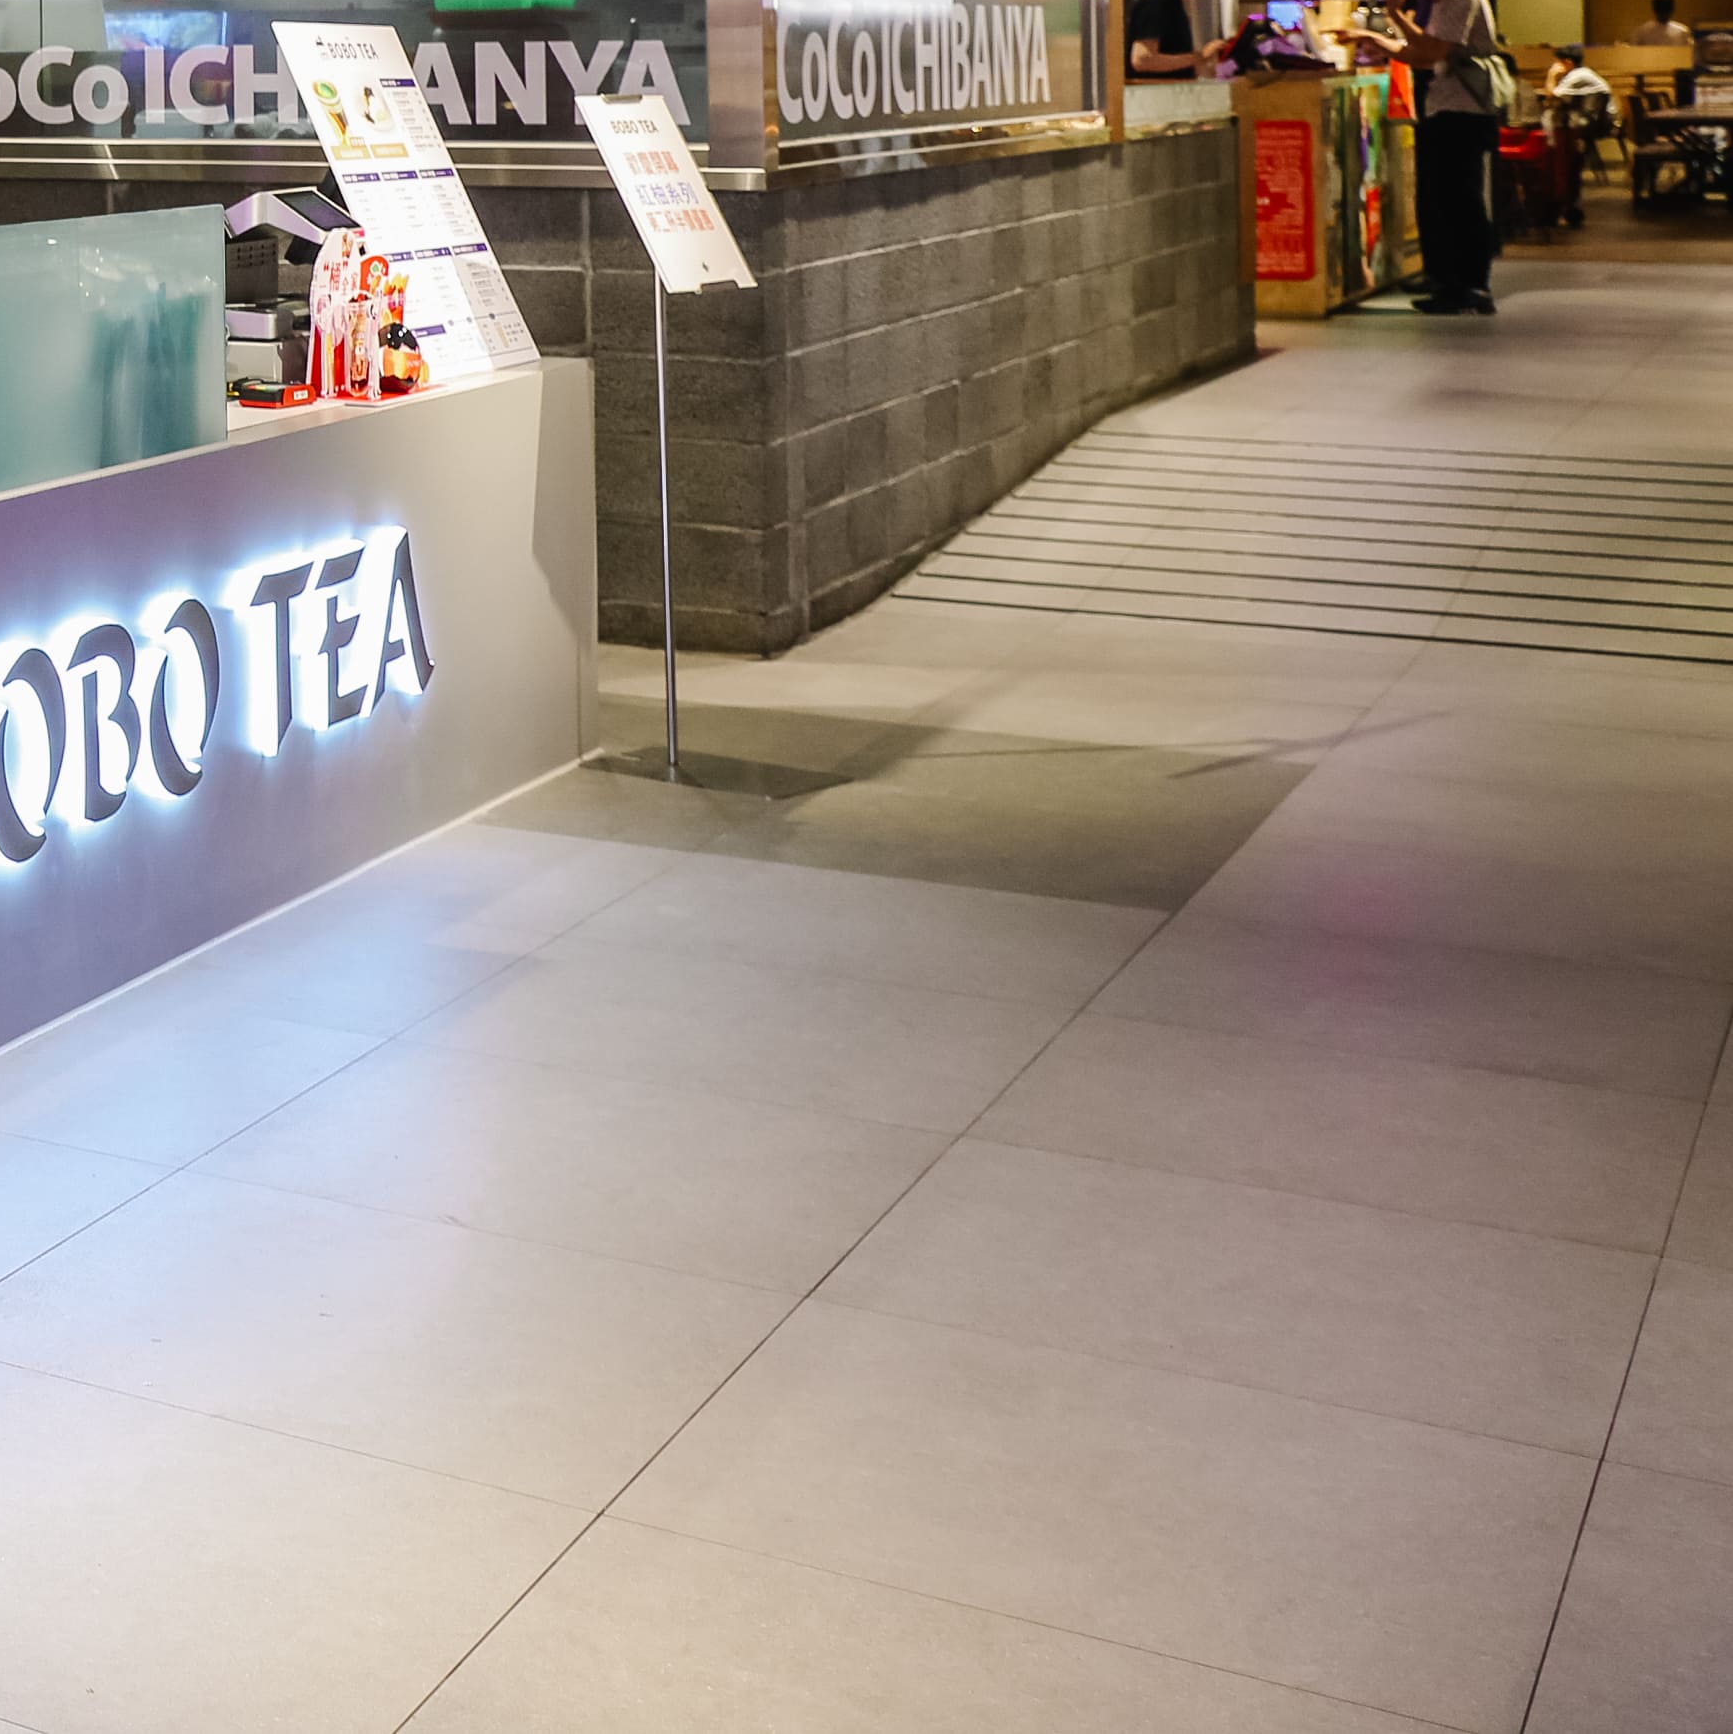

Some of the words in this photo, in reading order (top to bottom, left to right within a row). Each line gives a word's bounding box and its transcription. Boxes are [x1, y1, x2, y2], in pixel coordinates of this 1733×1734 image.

[327, 42, 357, 59] BOBO
[357, 42, 379, 60] TEA
[776, 7, 877, 123] CoCo
[881, 3, 1051, 115] ICHIBANYA
[610, 120, 638, 134] BOBO
[639, 119, 658, 133] TEA
[239, 524, 434, 757] TEA
